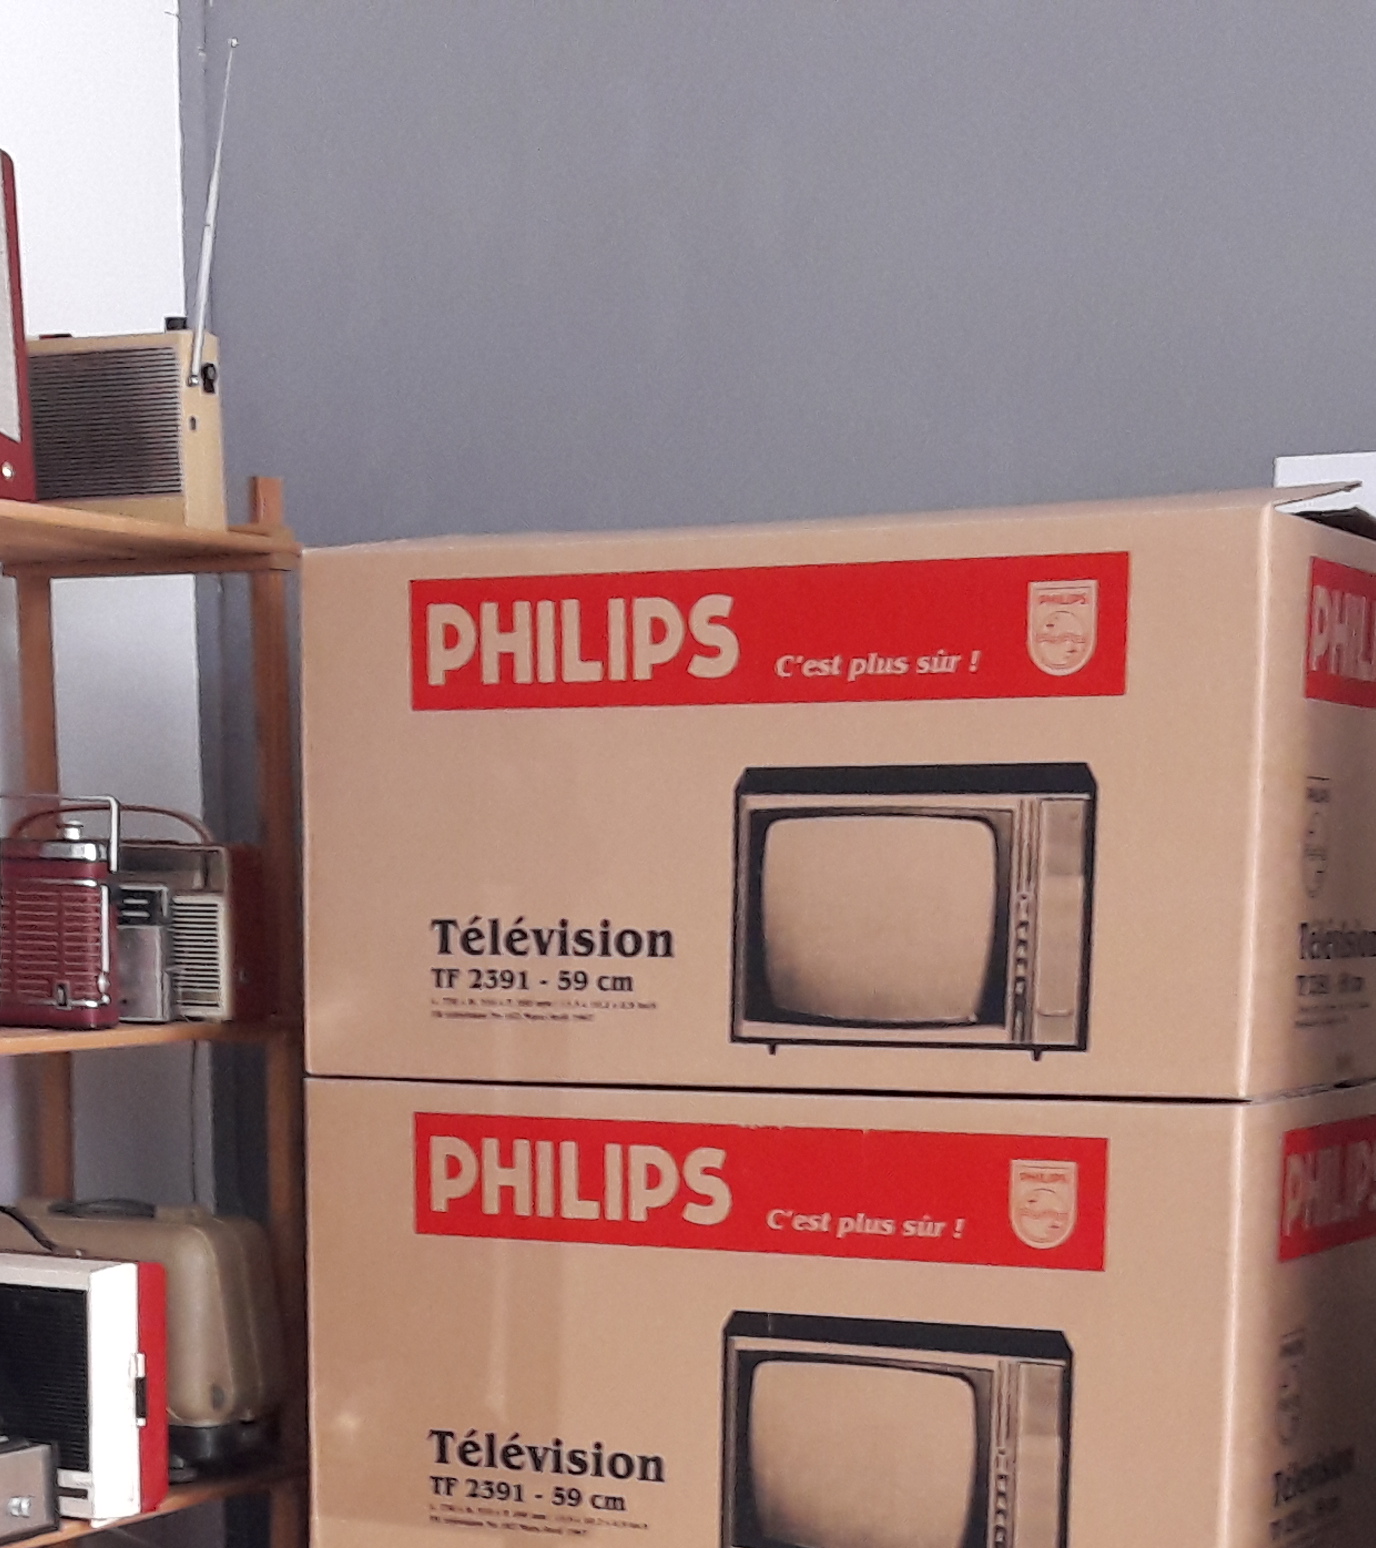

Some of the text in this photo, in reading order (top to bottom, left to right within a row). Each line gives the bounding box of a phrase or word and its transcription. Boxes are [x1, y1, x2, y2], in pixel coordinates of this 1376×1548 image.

[426, 594, 741, 687] PHILIPS
[776, 655, 843, 677] C'est
[847, 653, 910, 682] plus
[969, 650, 981, 673] !
[431, 915, 675, 958] Télévision
[431, 968, 460, 989] TF
[468, 969, 529, 990] 2391
[557, 970, 588, 991] 59
[597, 974, 634, 992] cm
[427, 1135, 733, 1226] PHILIPS
[766, 1209, 831, 1232] C'est
[836, 1208, 895, 1238] plus
[953, 1214, 965, 1239] !
[427, 1428, 665, 1483] Télévision
[430, 1475, 458, 1496] TF
[466, 1478, 525, 1503] 2391
[551, 1486, 582, 1508] 59
[590, 1494, 627, 1511] cm
